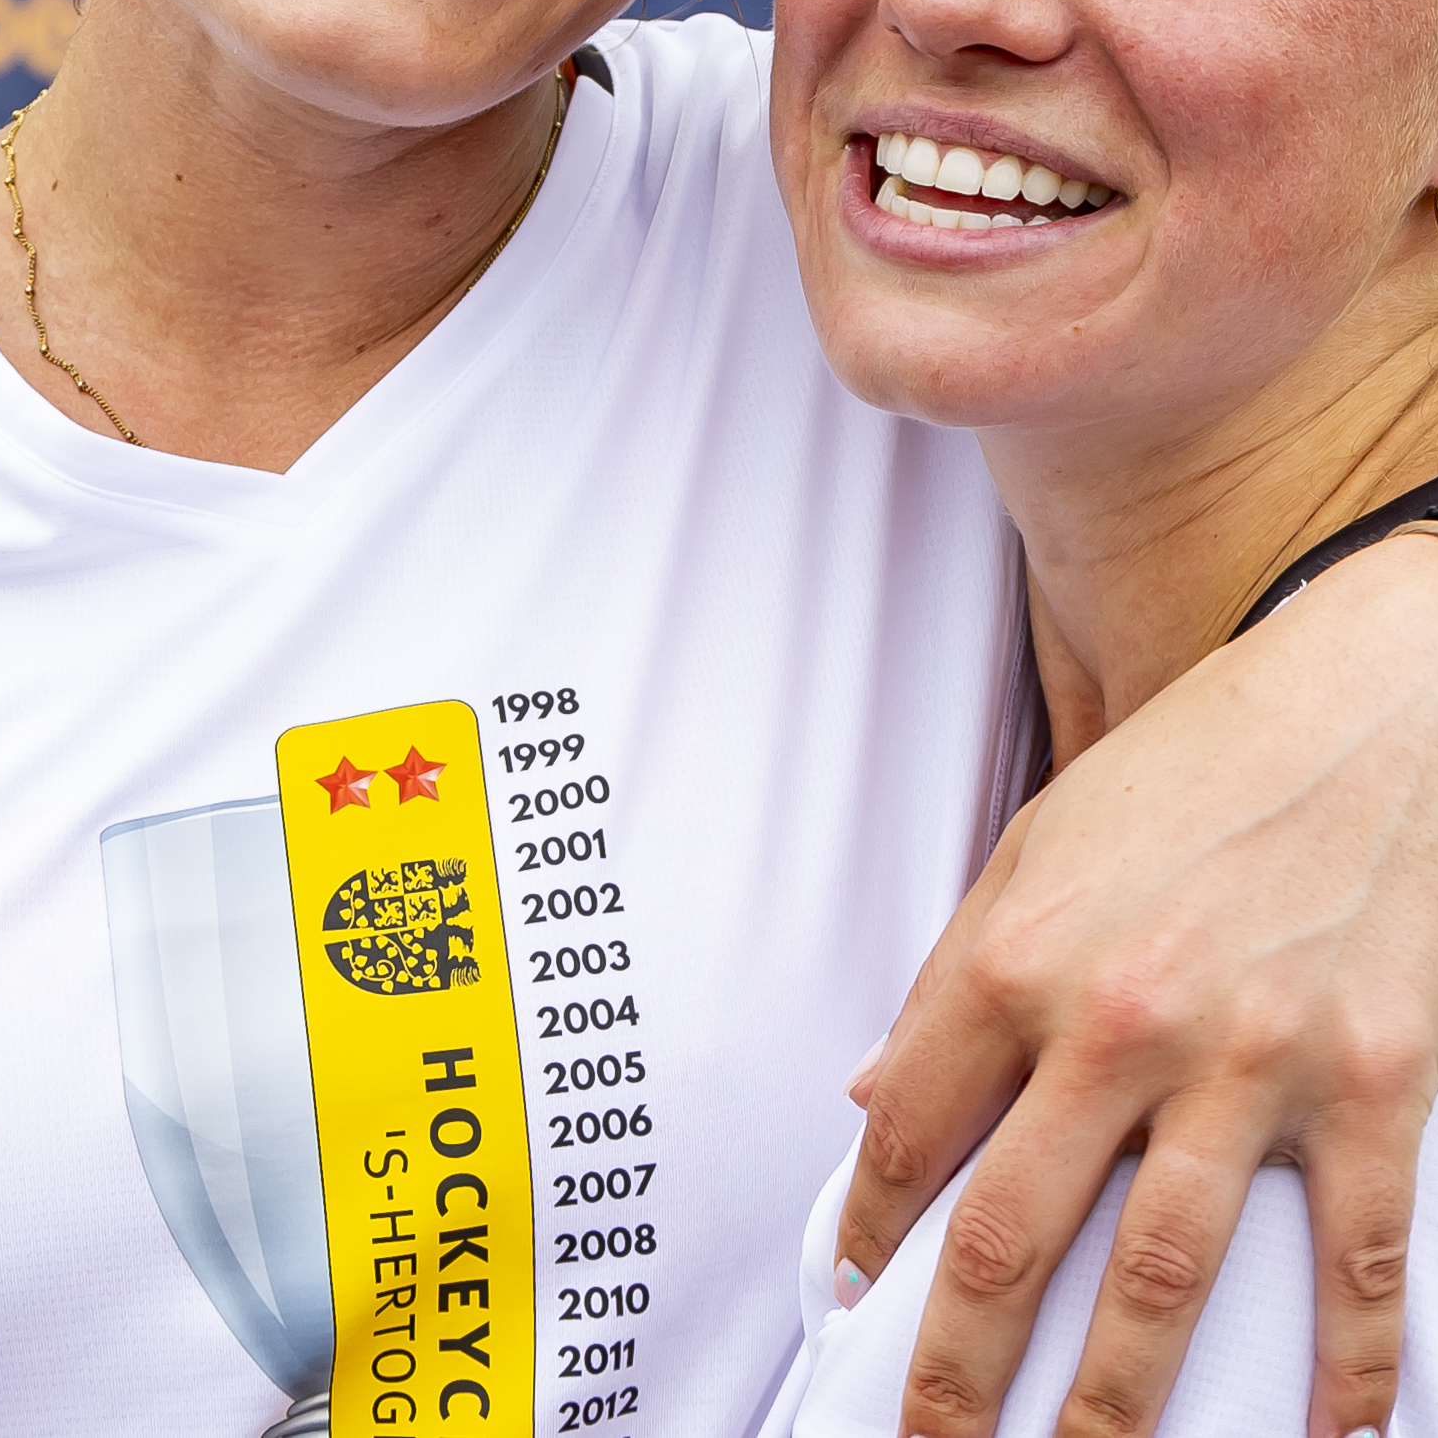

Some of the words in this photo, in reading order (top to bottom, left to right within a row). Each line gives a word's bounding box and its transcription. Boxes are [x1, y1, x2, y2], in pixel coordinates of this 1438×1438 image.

[491, 687, 580, 724] 1998
[498, 733, 586, 774] 1999
[508, 775, 611, 823] 2000
[515, 828, 607, 872] 2001
[521, 882, 625, 925] 2002
[529, 940, 631, 983] 2003
[536, 995, 640, 1039] 2004
[543, 1050, 646, 1095] 2005
[548, 1104, 653, 1149] 2006
[553, 1162, 657, 1208] 2007
[421, 1047, 491, 1438] HOCKEYC
[554, 1223, 657, 1265] 2008
[363, 1130, 418, 1438] 'S-HERTOG
[558, 1282, 650, 1321] 2010
[558, 1337, 635, 1378] 2011
[558, 1385, 639, 1434] 2012
